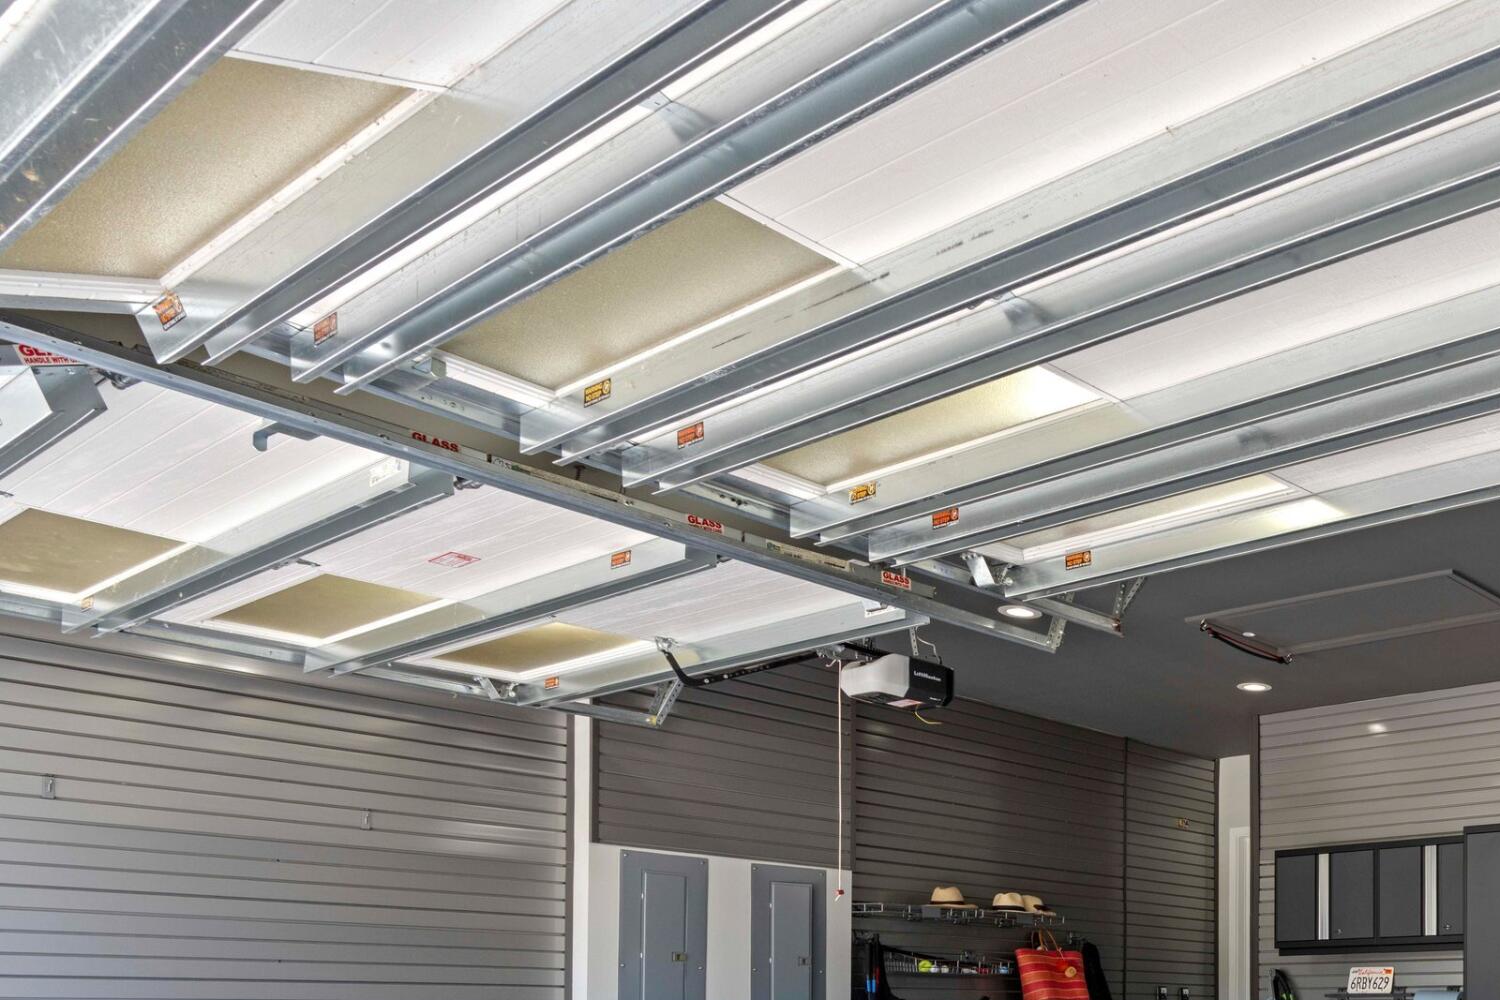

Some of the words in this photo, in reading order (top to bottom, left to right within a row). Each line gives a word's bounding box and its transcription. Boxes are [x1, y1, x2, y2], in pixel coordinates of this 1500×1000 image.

[412, 432, 459, 452] GLASS
[687, 515, 722, 529] GLASS
[882, 571, 910, 585] GLASS
[1350, 976, 1390, 991] 6RBY629
